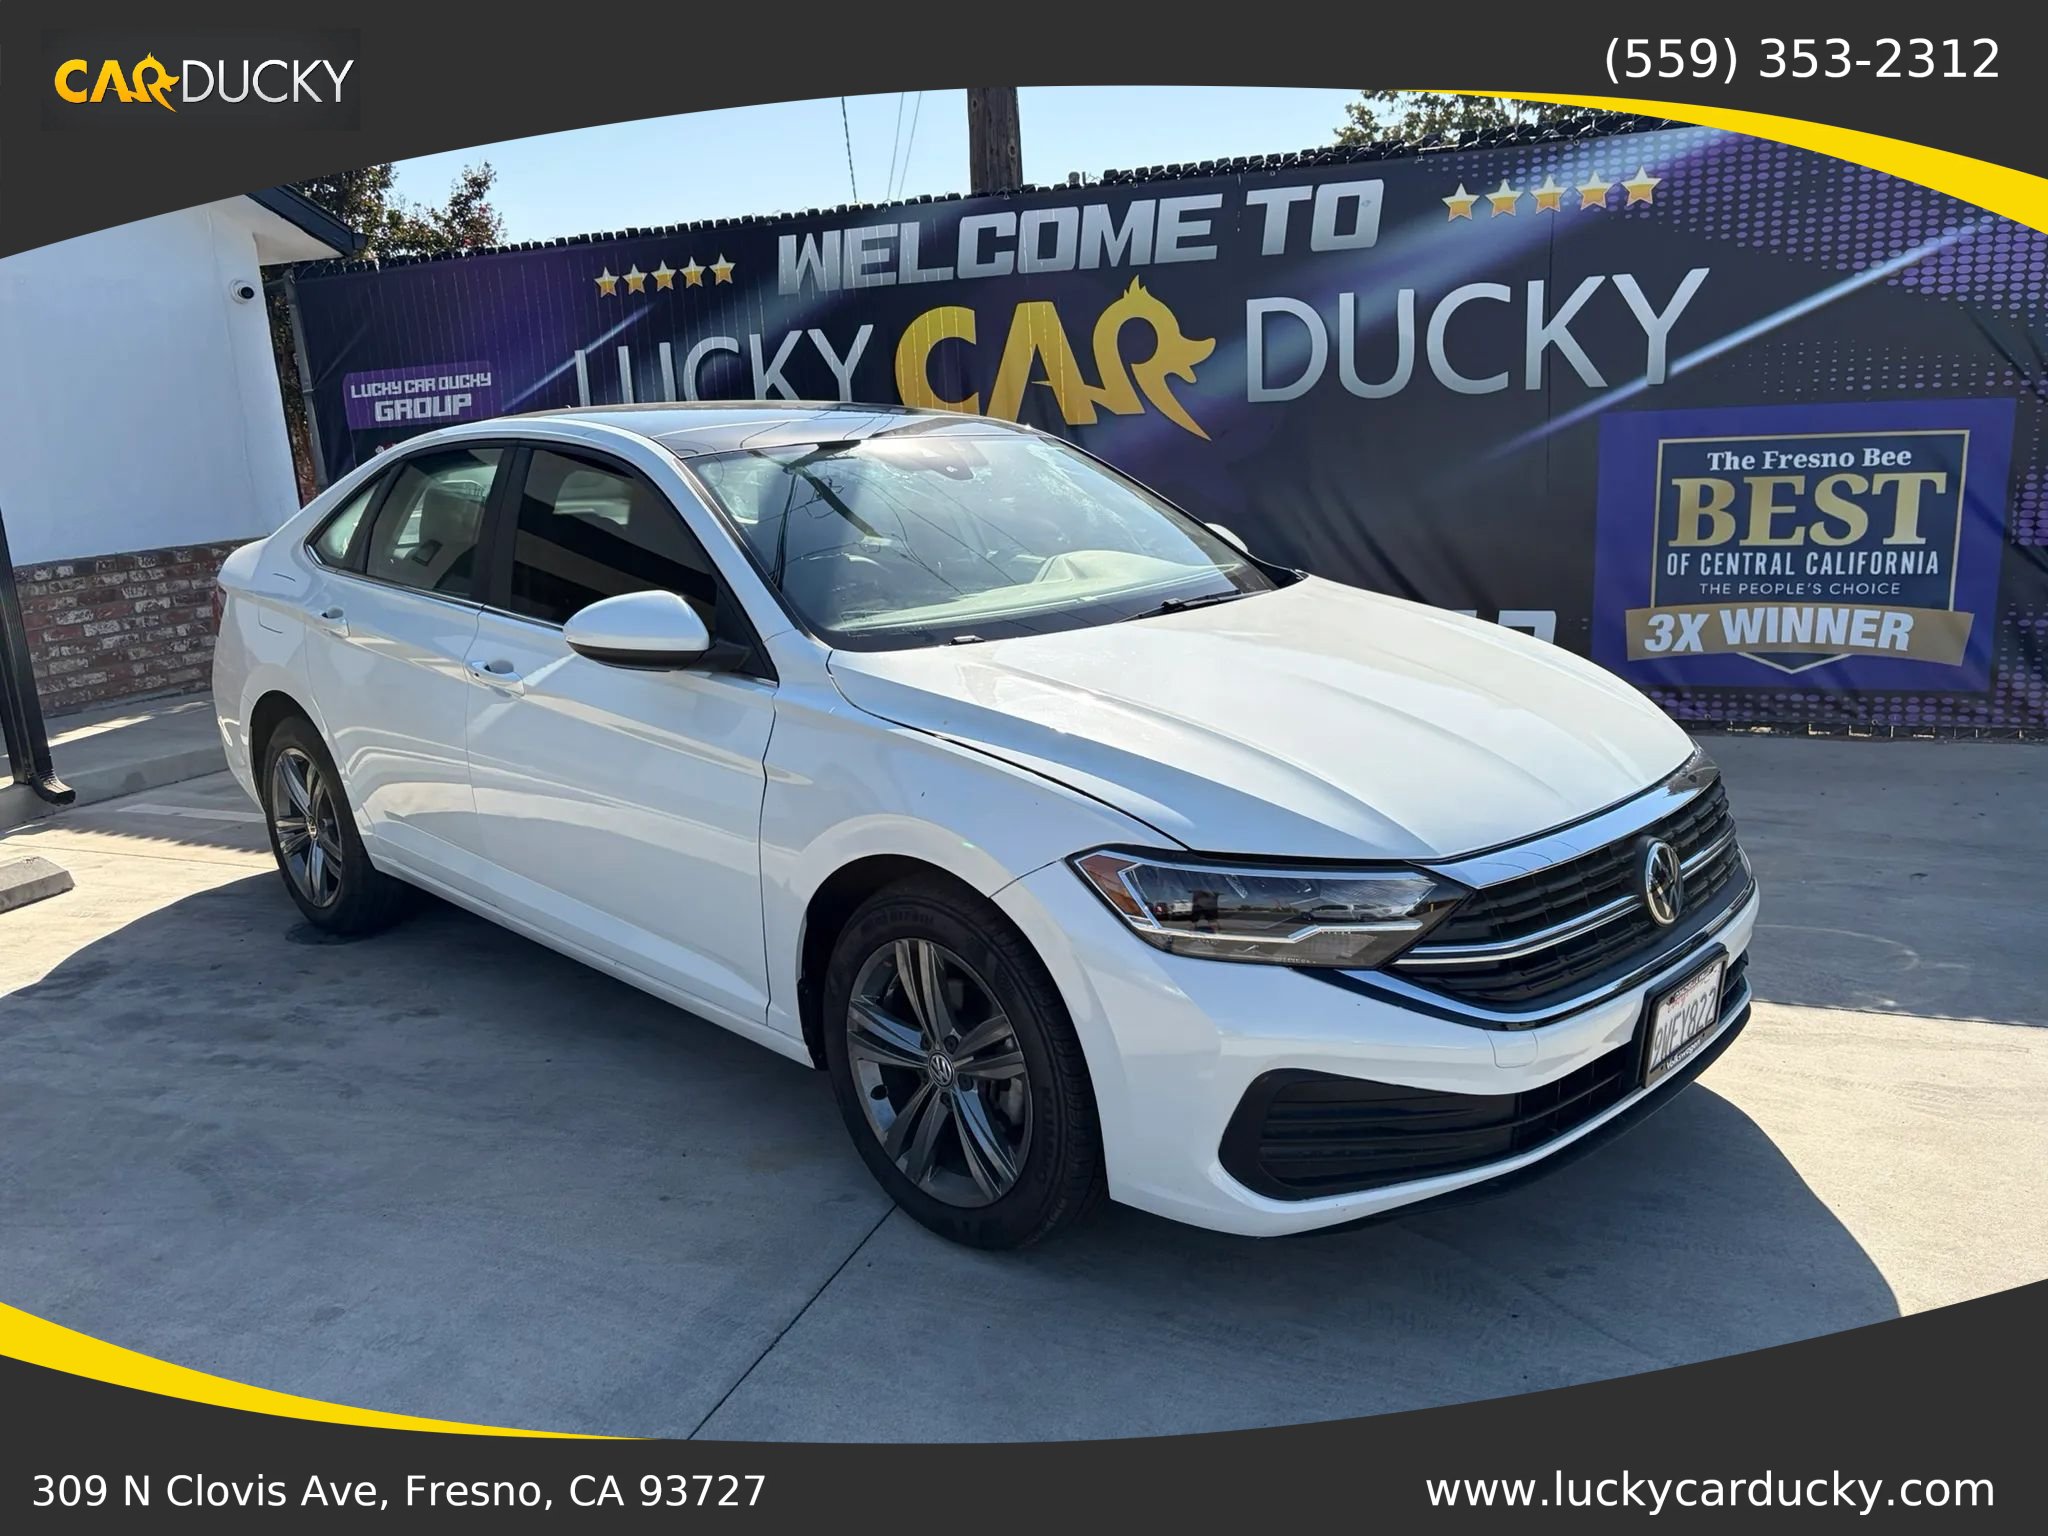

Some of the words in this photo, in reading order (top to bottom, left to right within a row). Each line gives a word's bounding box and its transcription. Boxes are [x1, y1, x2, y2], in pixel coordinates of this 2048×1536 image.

[778, 195, 1221, 295] WELCOME
[1246, 179, 1384, 256] TO
[894, 275, 1216, 441] CAR
[1246, 267, 1710, 403] DUCKY
[351, 380, 402, 398] LUCKY
[404, 378, 436, 393] CAR
[438, 372, 492, 391] DUCKY
[375, 393, 472, 422] GROUP
[1707, 451, 1756, 471] The
[1761, 449, 1855, 470] Fresno
[1861, 447, 1912, 468] Bee
[1668, 472, 1947, 547] BEST
[1666, 553, 1691, 576] OF
[1700, 552, 1795, 576] CENTRAL
[1805, 551, 1939, 576] CALIFORNIA
[1700, 583, 1731, 595] THE
[1738, 583, 1822, 595] PEOPLE'S
[1829, 582, 1901, 595] CHOICE
[1644, 613, 1711, 652] 3X
[1719, 607, 1915, 651] WINNER
